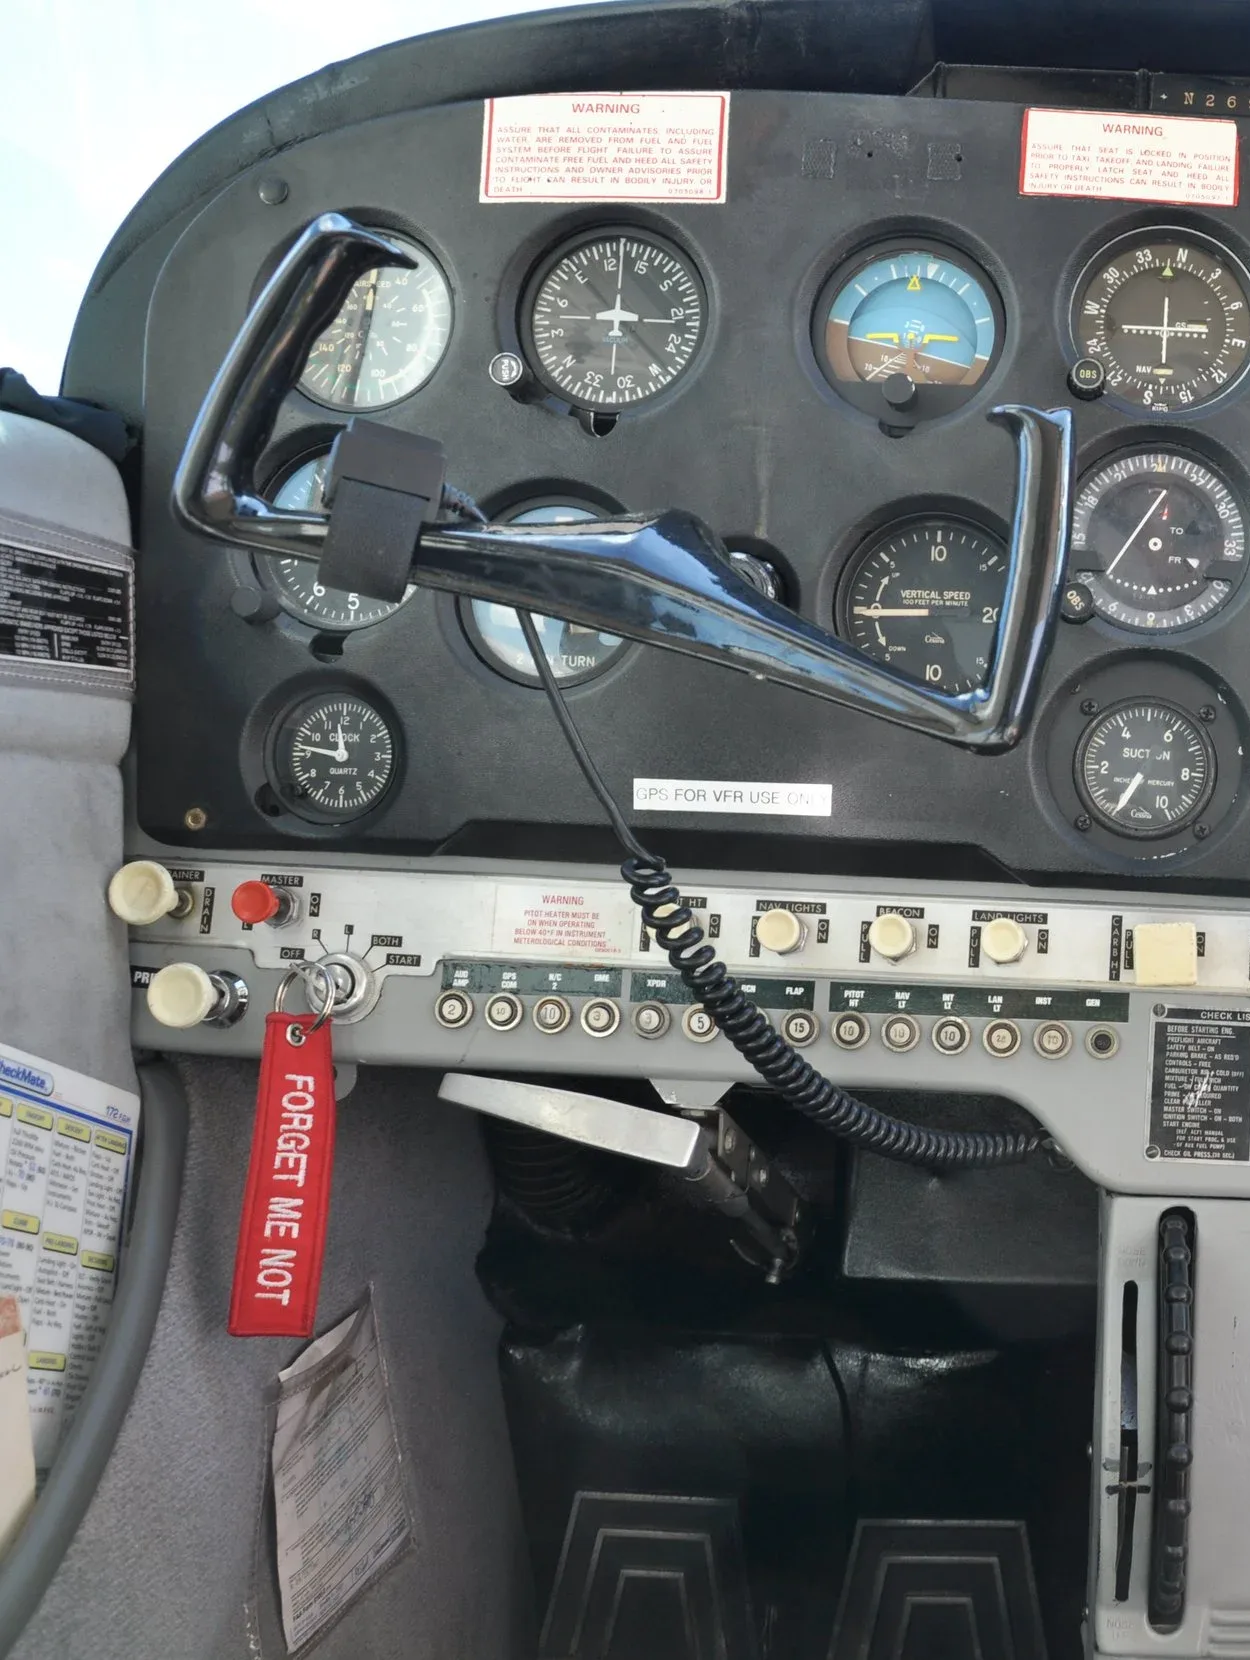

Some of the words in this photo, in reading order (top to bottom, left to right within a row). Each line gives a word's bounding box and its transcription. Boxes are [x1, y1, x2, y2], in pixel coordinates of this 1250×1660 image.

[572, 103, 640, 114] WARNING
[1102, 124, 1164, 137] WARNING
[901, 590, 941, 599] VERTICAL
[943, 591, 970, 600] SPEED
[329, 733, 360, 742] CLOCK
[637, 788, 668, 800] GPS
[675, 789, 706, 801] FOR
[713, 790, 743, 803] VFR
[750, 791, 779, 804] USE
[262, 876, 300, 886] MASTER
[311, 896, 319, 914] ON
[542, 895, 584, 906] WARNING
[524, 910, 545, 919] PITOT
[546, 911, 570, 919] HEATER
[571, 911, 590, 920] MUST
[539, 920, 557, 928] WHEN
[558, 920, 595, 929] OPERATING
[514, 928, 536, 937] BELOW
[564, 929, 605, 938] INSTRUMENT
[373, 936, 399, 946] BOTH
[282, 949, 302, 959] OFF
[389, 955, 418, 965] START
[1200, 1011, 1232, 1022] CHECK
[272, 1074, 315, 1187] FORGET
[263, 1197, 304, 1240] ME
[254, 1248, 296, 1306] NOT
